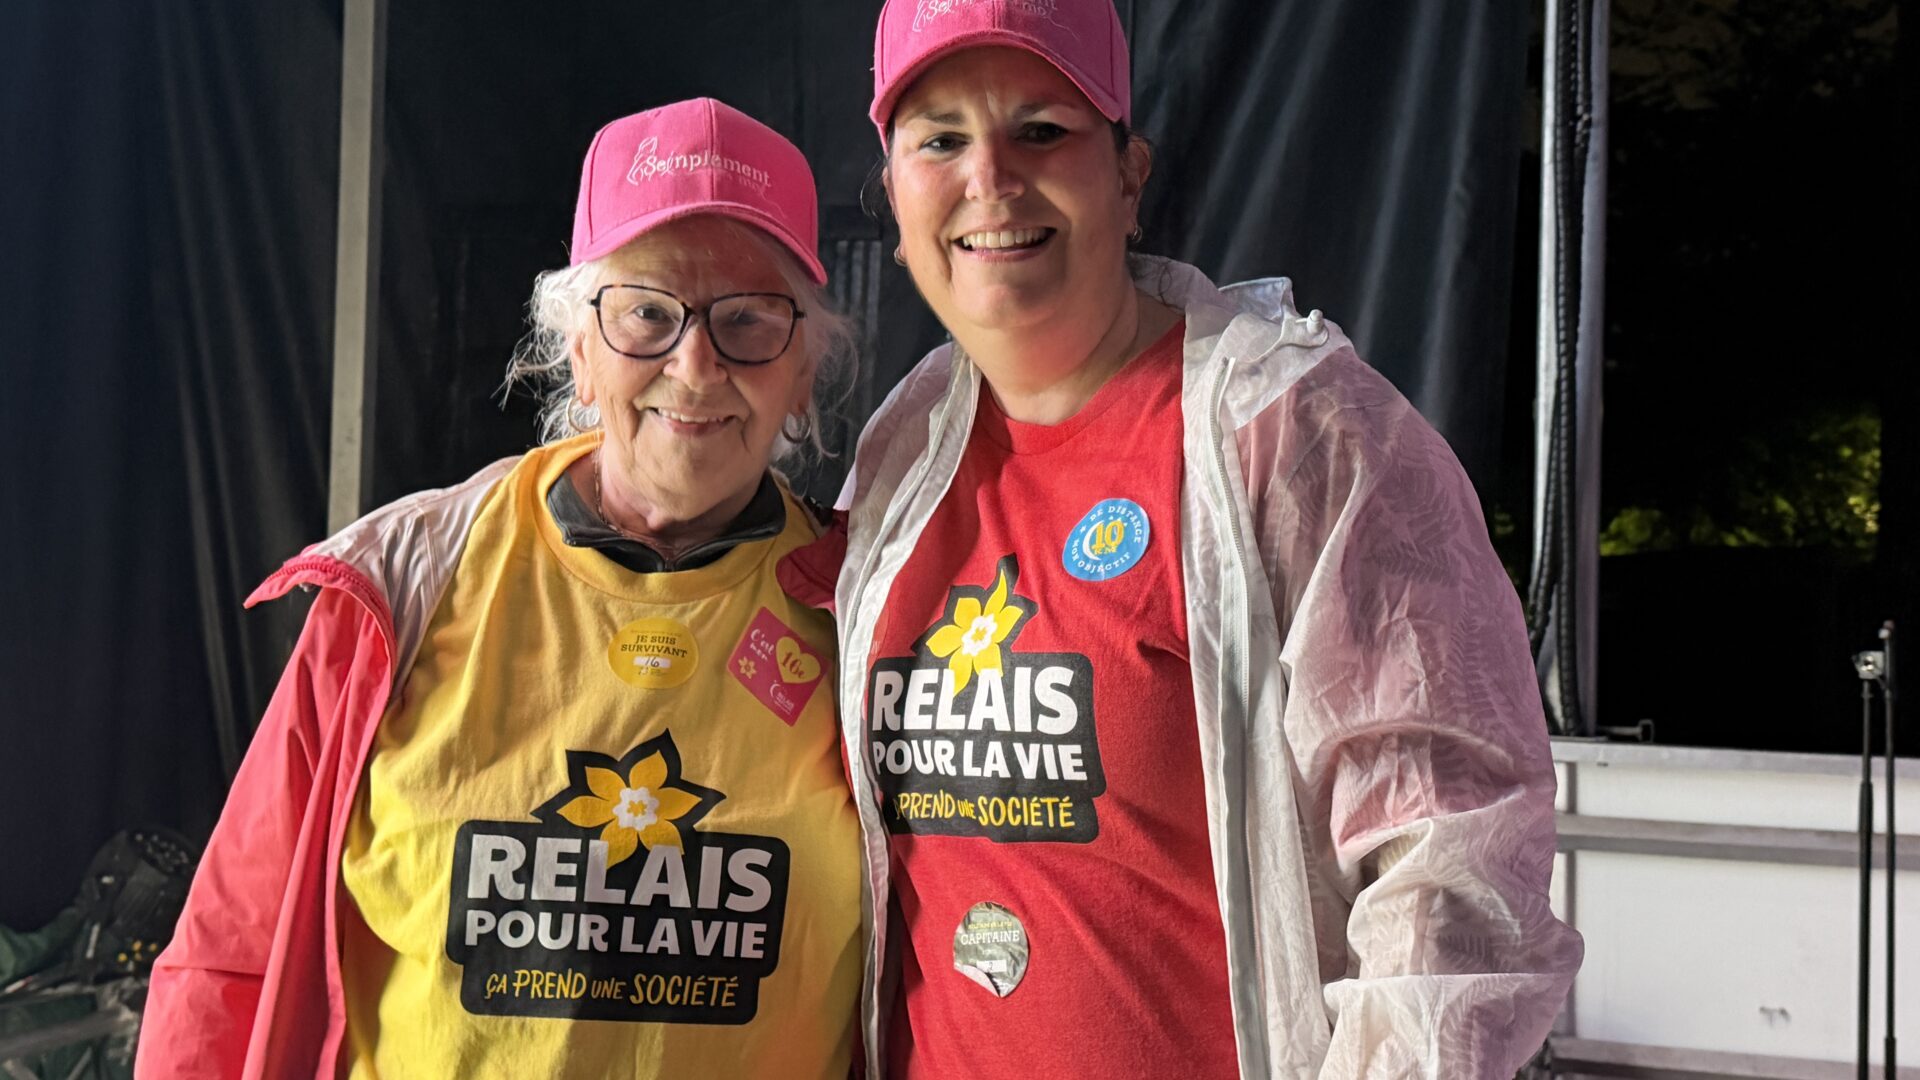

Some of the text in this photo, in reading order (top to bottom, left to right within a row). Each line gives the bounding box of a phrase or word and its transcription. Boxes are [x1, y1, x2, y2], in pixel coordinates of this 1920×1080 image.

[1091, 520, 1124, 550] 10
[1108, 506, 1143, 543] DISTANCE
[1078, 552, 1131, 573] OBJECTIF
[621, 644, 688, 658] SURVIVANT
[635, 634, 677, 645] JE SUIS
[872, 666, 1078, 735] RELAIS
[872, 739, 1088, 781] POUR LA VIE
[898, 789, 956, 820] PREND
[958, 799, 976, 820] UNE
[978, 796, 1076, 828] SOCIÉTÉ
[467, 834, 774, 913] RELAIS
[465, 909, 768, 959] POUR LA VIE
[960, 930, 1020, 945] CAPITAINE
[484, 968, 740, 1007] ÇA PREND UNE SOCIÉTÉ
